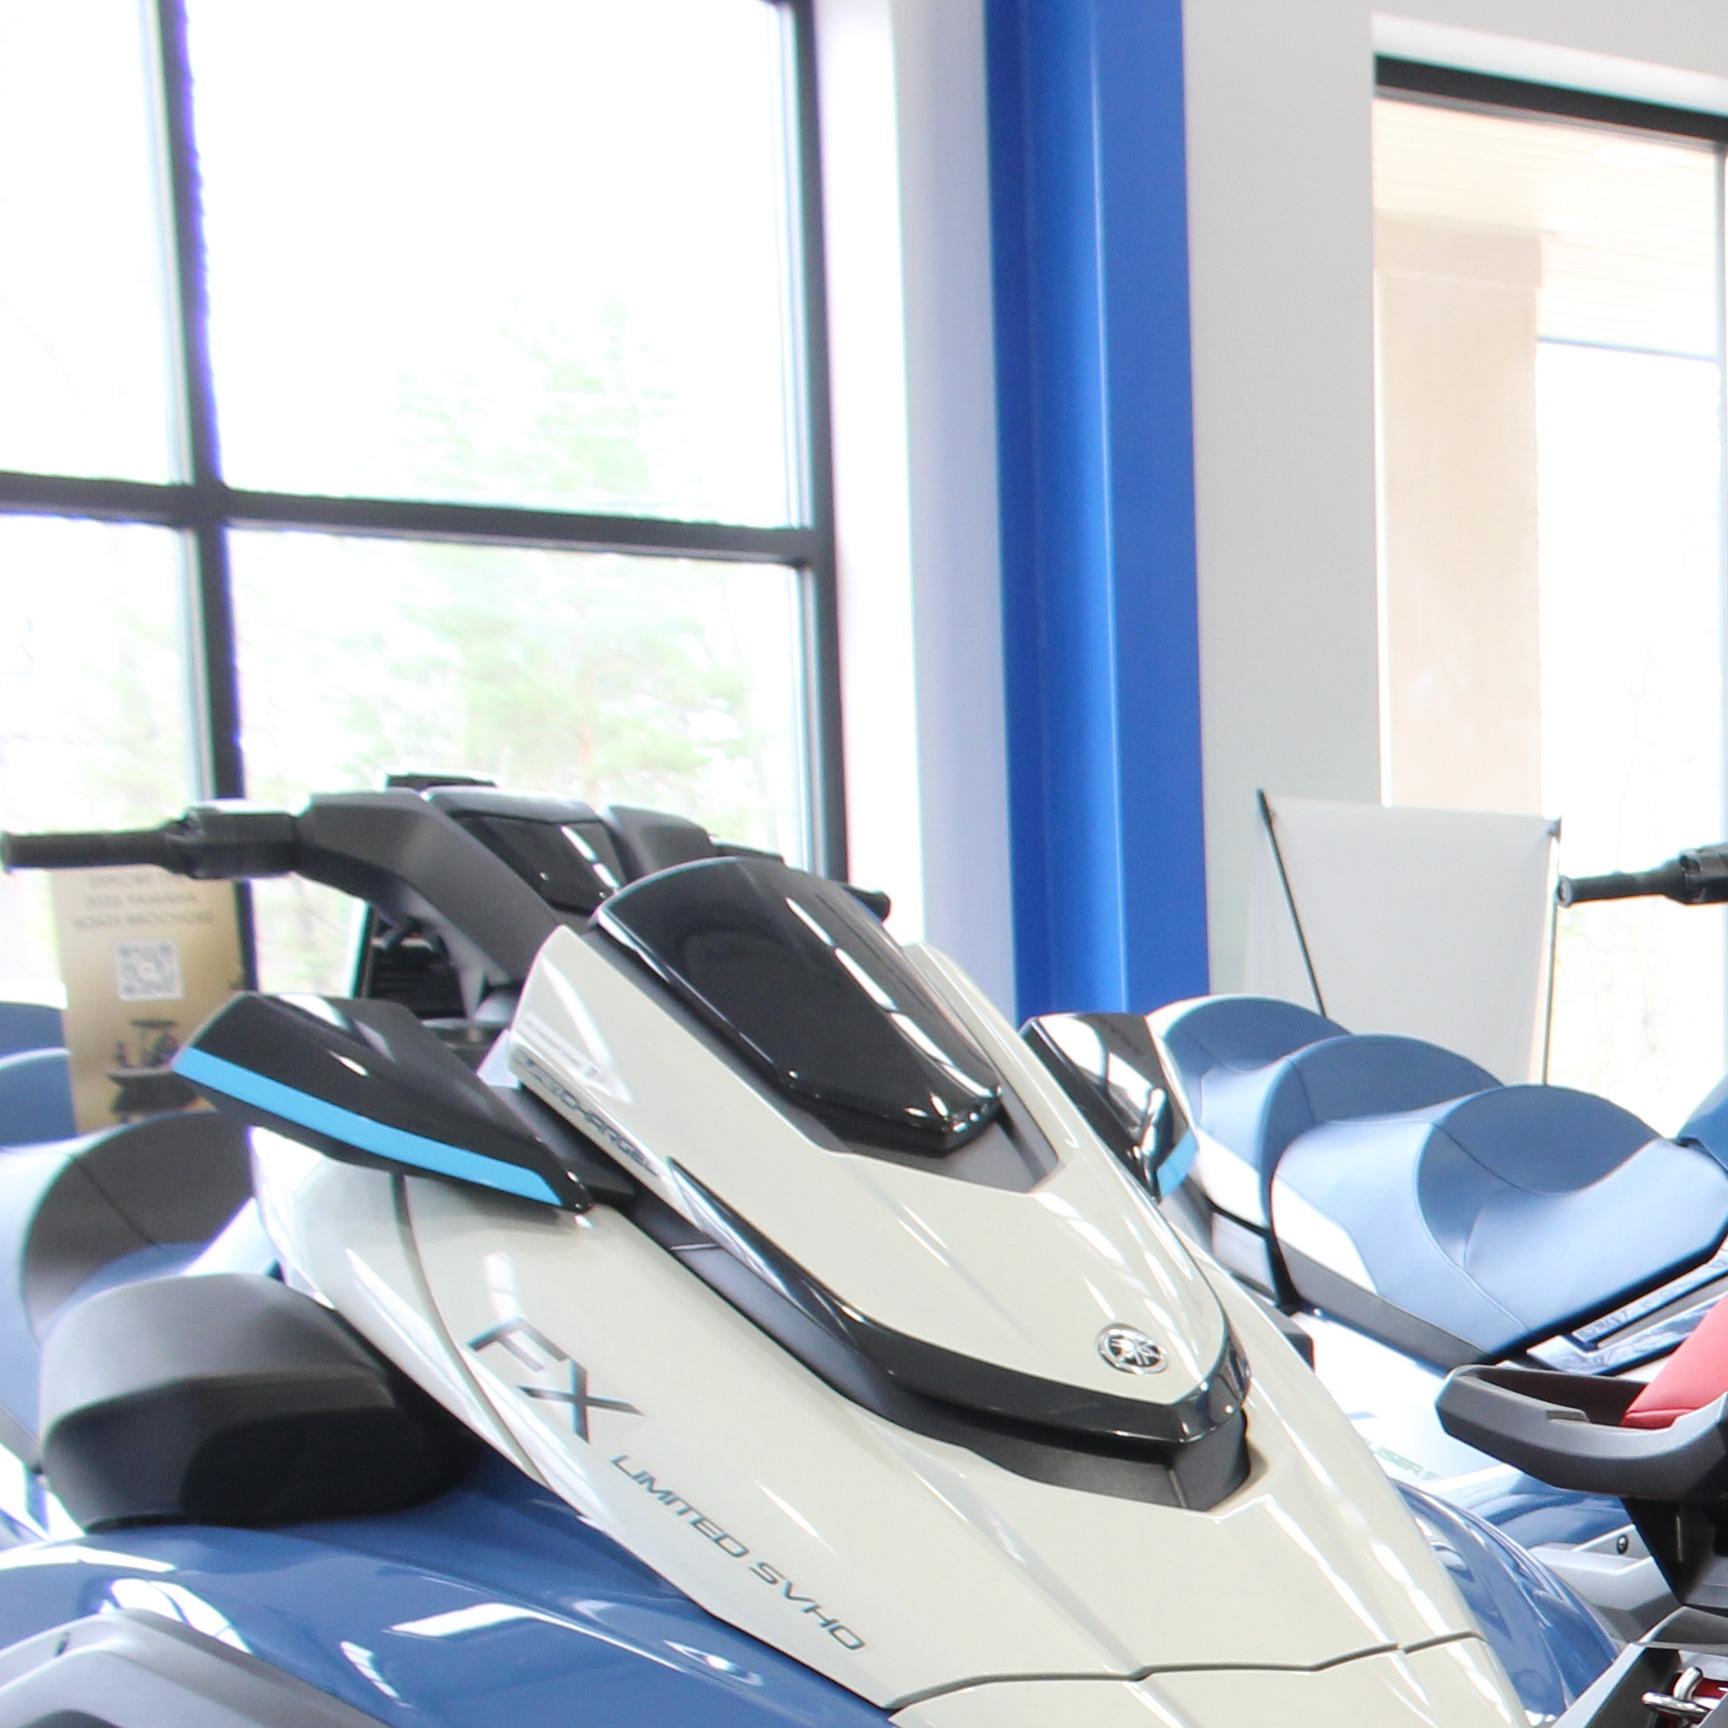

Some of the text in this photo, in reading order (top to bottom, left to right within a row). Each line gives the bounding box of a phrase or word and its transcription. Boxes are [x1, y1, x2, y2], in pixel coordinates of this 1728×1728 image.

[467, 1317, 866, 1651] FX LIMITED SVHO
